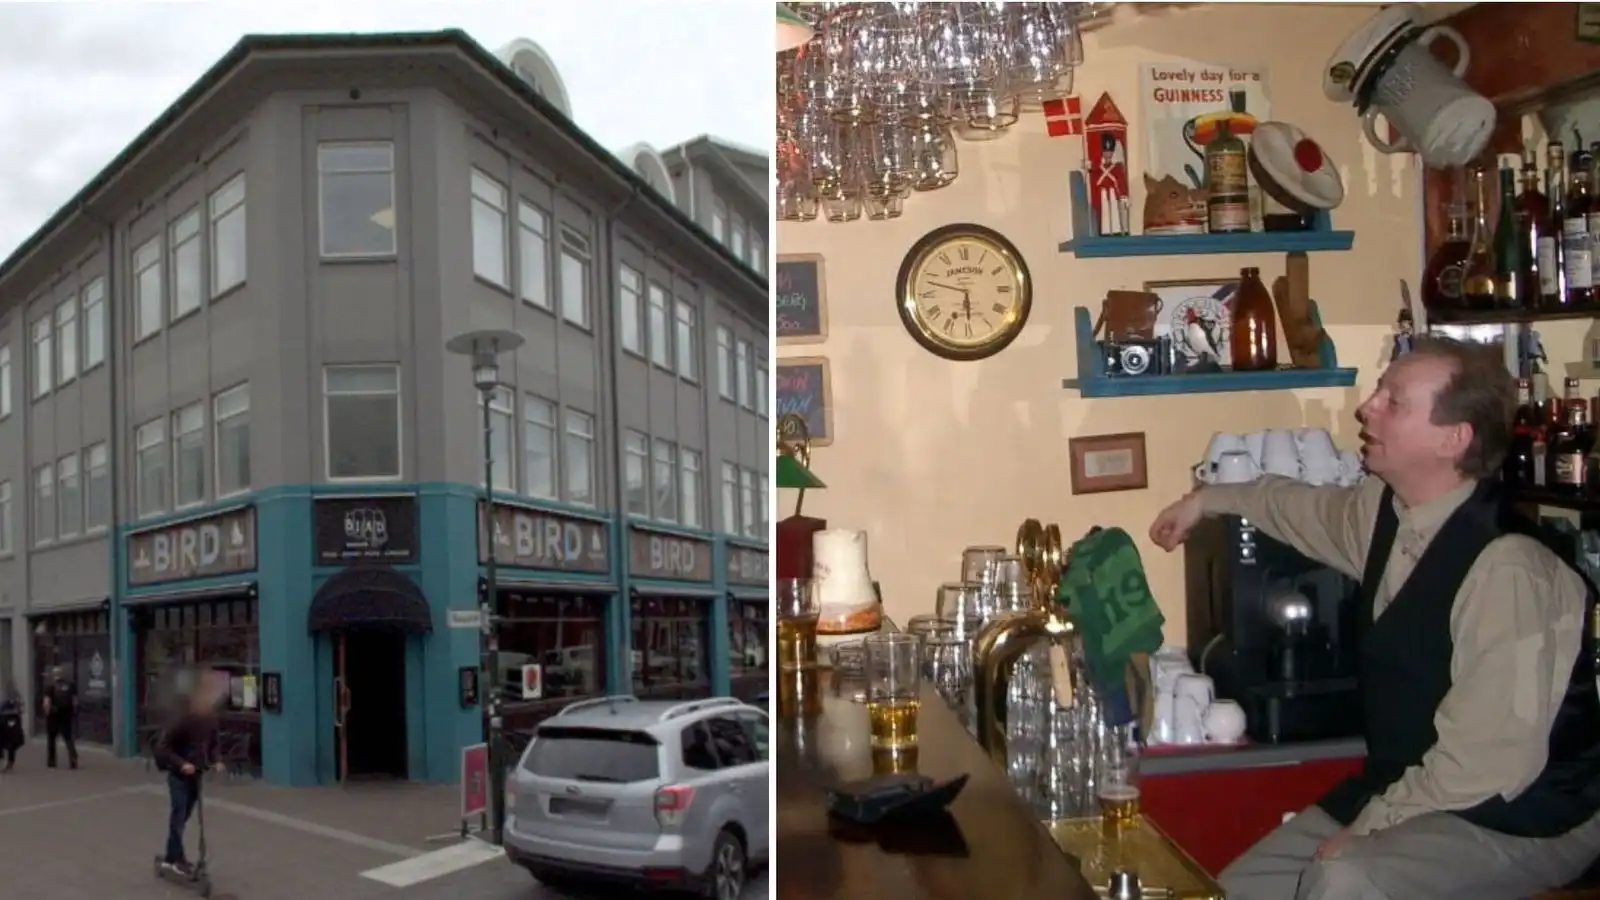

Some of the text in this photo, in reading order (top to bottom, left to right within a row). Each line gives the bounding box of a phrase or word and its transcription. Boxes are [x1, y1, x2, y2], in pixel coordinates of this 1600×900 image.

[1151, 68, 1260, 84] Lovely day for a
[1153, 87, 1225, 103] GUINNESS
[946, 266, 984, 278] JAMESON
[154, 523, 219, 573] BIRD
[515, 513, 582, 562] BIRD
[650, 536, 695, 573] BIRD
